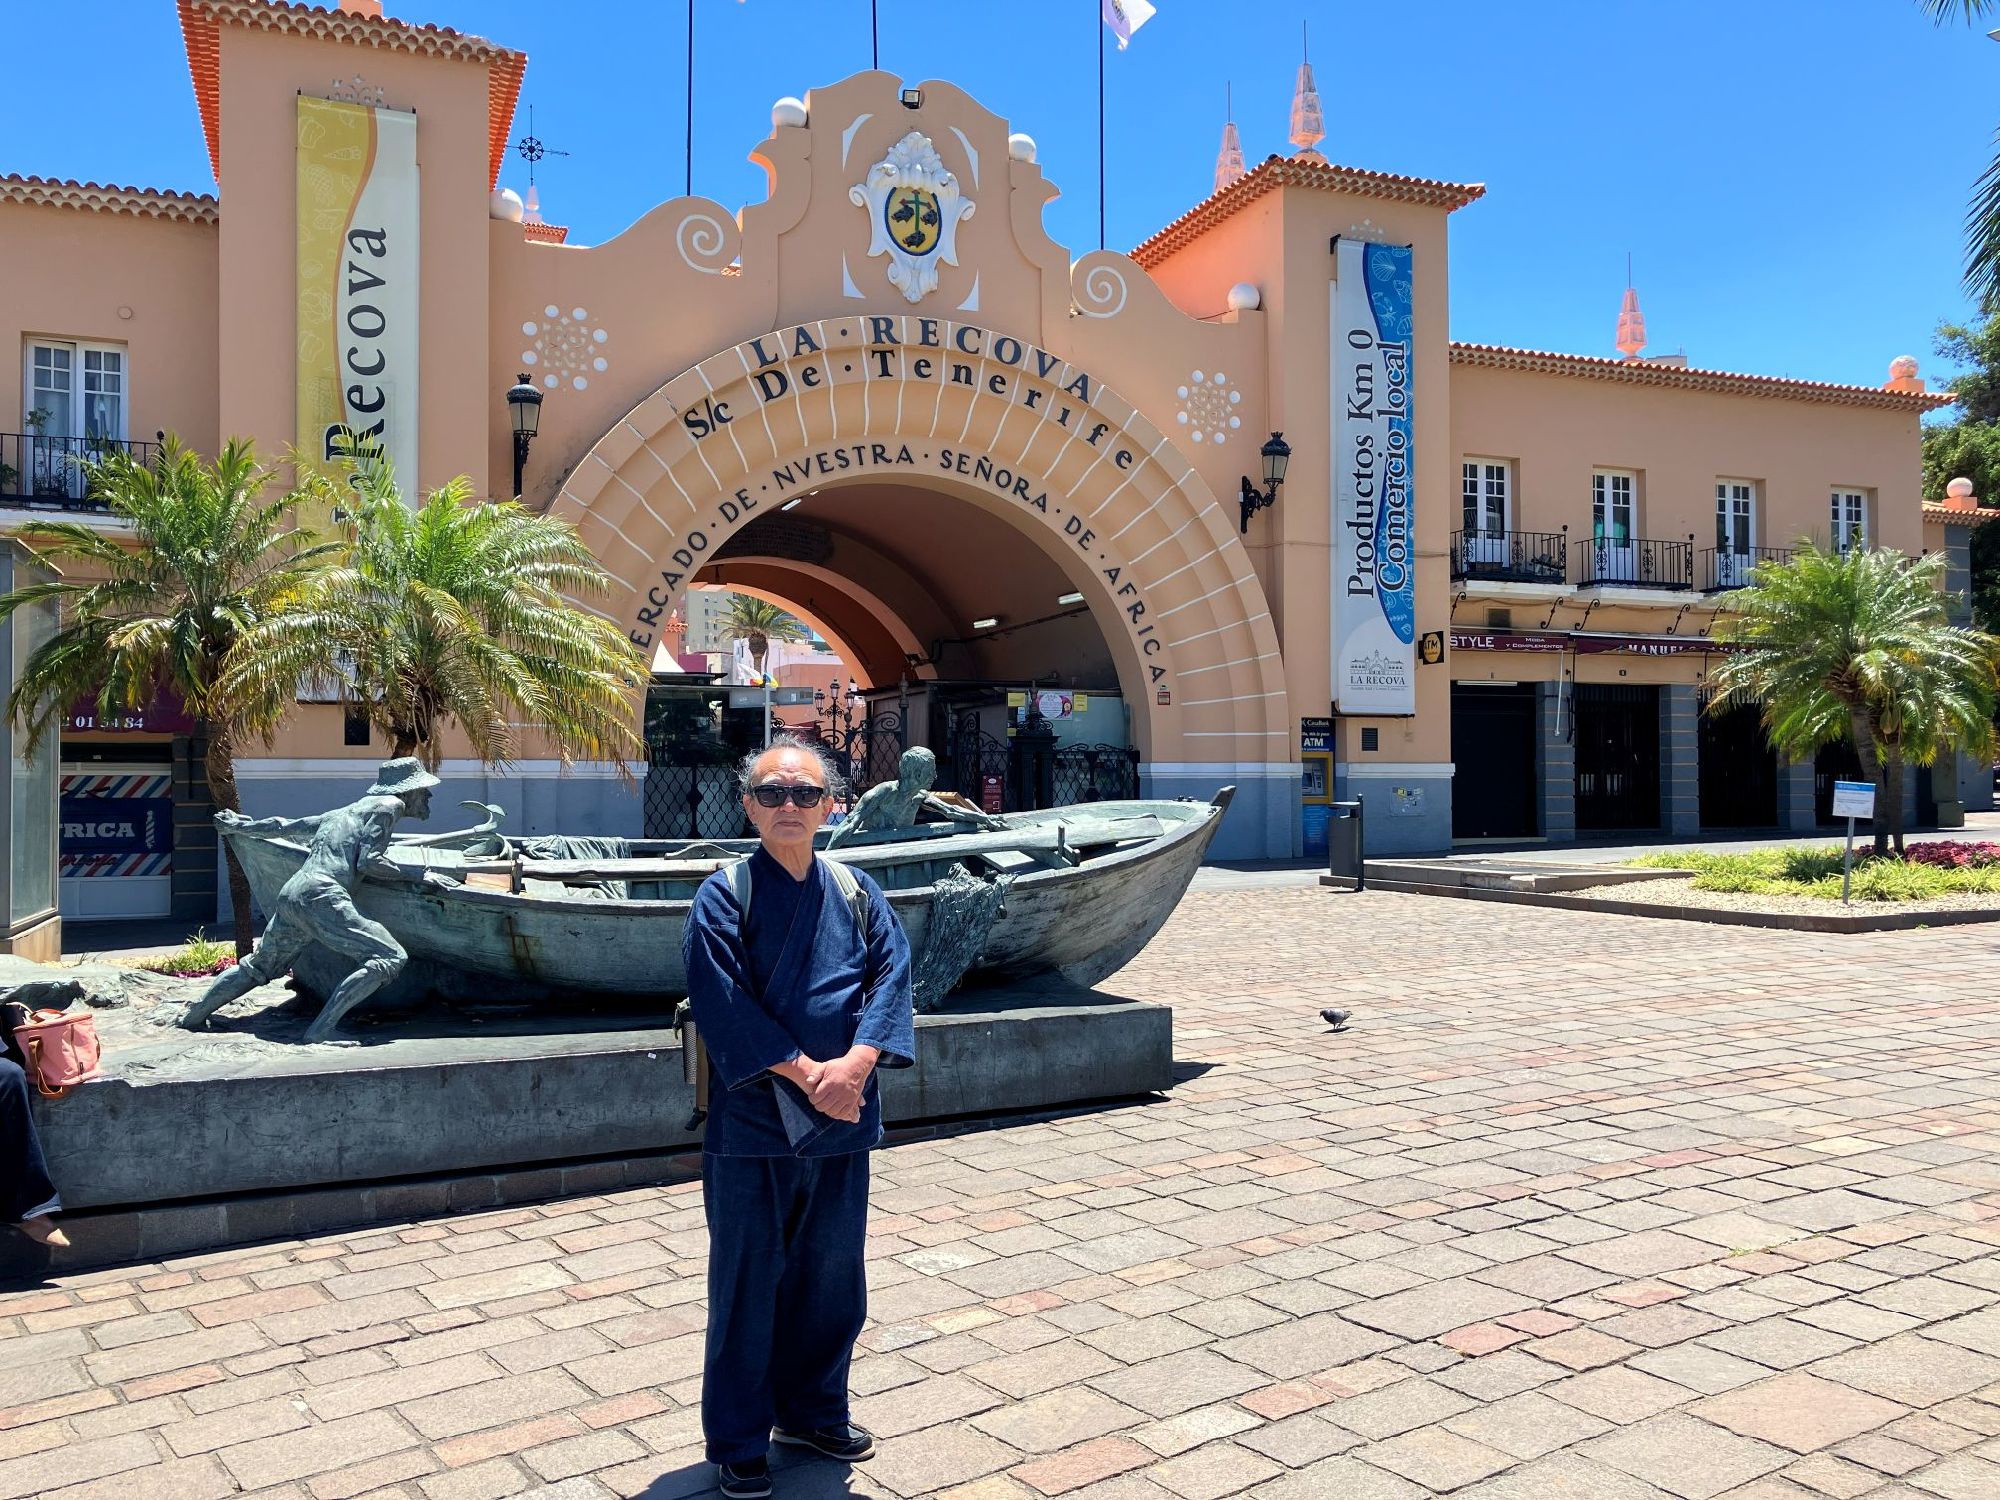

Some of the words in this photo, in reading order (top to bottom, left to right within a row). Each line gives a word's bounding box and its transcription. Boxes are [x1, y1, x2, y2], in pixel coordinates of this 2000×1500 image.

[325, 227, 387, 464] Recova
[749, 326, 821, 368] LA
[870, 316, 1090, 403] RECOVA
[1348, 329, 1373, 350] 0
[753, 366, 821, 402] De
[871, 350, 1133, 469] Tenerife
[1348, 362, 1373, 423] Km
[1377, 341, 1406, 419] local
[1346, 435, 1374, 598] Productos
[1377, 430, 1406, 592] Comercio
[630, 531, 708, 648] ERCADO
[718, 488, 757, 524] DE
[772, 444, 915, 490] NVESTRA
[940, 450, 1048, 513] SEÑORA
[1064, 515, 1096, 551] DE
[1103, 567, 1167, 683] AFRICA
[1450, 636, 1495, 648] STYLE
[1350, 675, 1363, 684] LA
[1366, 675, 1405, 685] RECOVA
[75, 716, 93, 728] 01
[124, 716, 144, 729] 84
[1303, 737, 1324, 747] ATM
[60, 822, 136, 838] RICA
